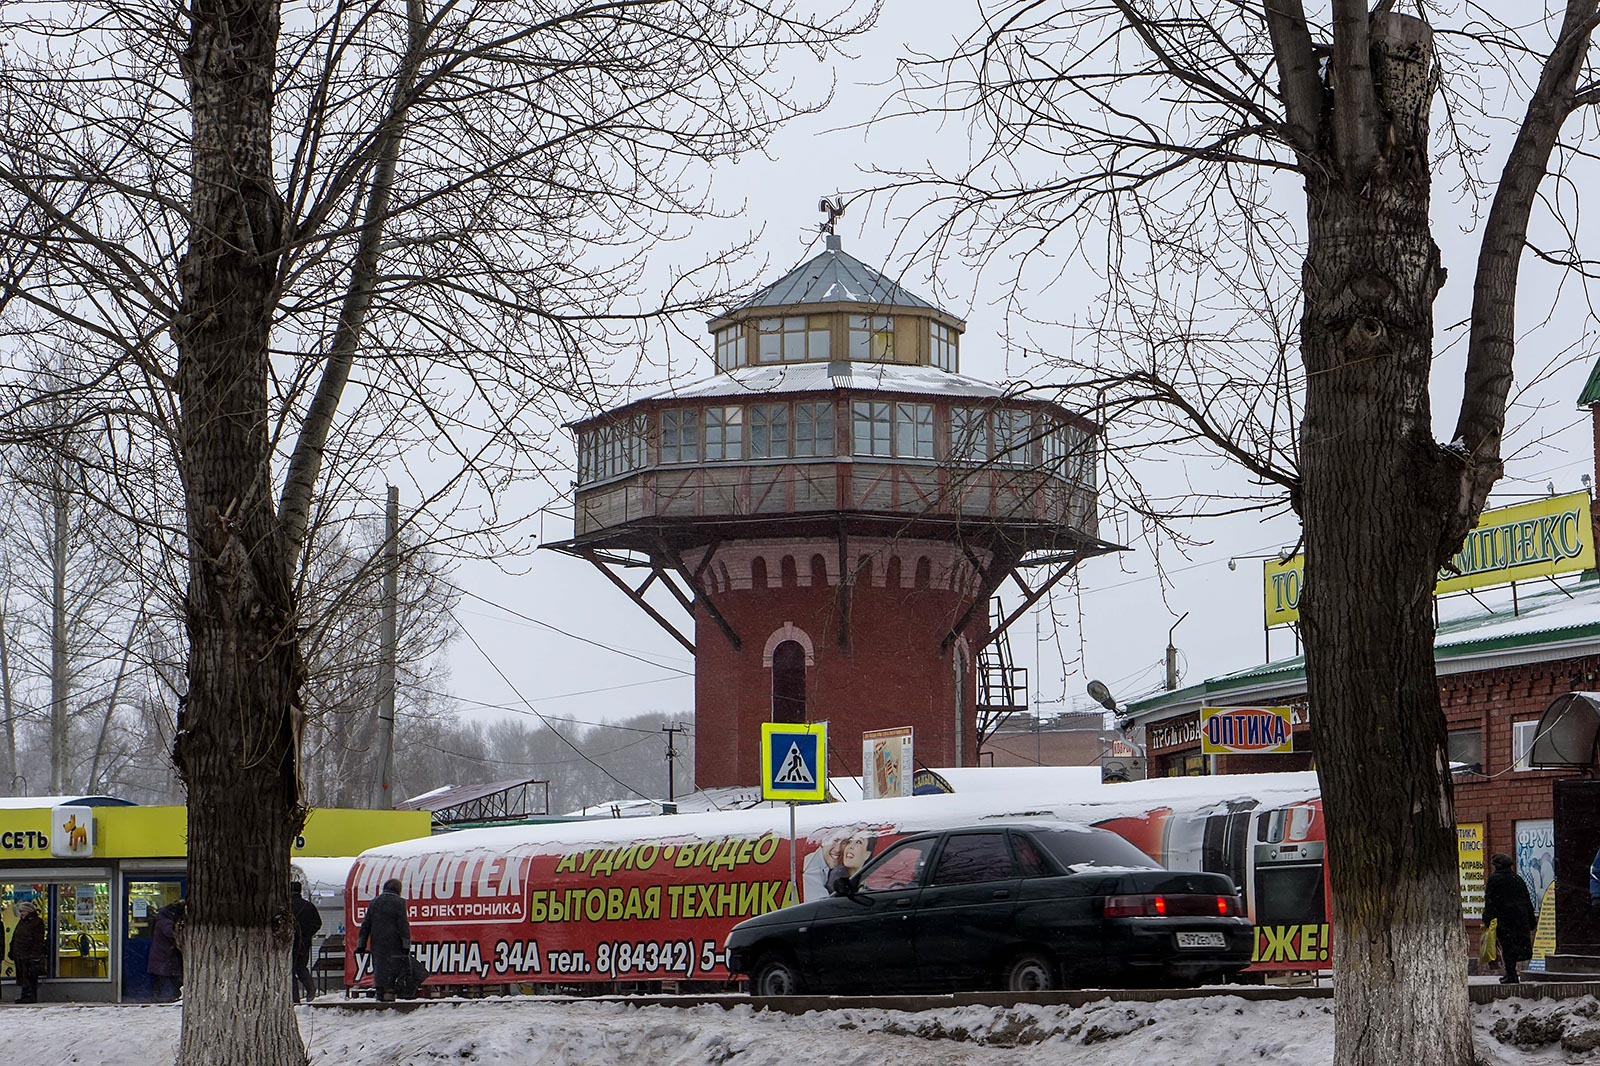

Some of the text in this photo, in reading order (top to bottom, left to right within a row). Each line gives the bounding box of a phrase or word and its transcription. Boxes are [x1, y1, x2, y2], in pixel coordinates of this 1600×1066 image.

[1208, 715, 1287, 746] ОПТИКА
[1, 830, 49, 849] СЕТЬ
[674, 833, 780, 872] ВИДЕО
[421, 902, 522, 917] ЭЛЕКТРОНИКА
[531, 886, 662, 922] БЫТОВАЯ
[495, 941, 541, 974] 34А
[548, 950, 591, 973] тел.
[597, 941, 694, 979] 8(84342)
